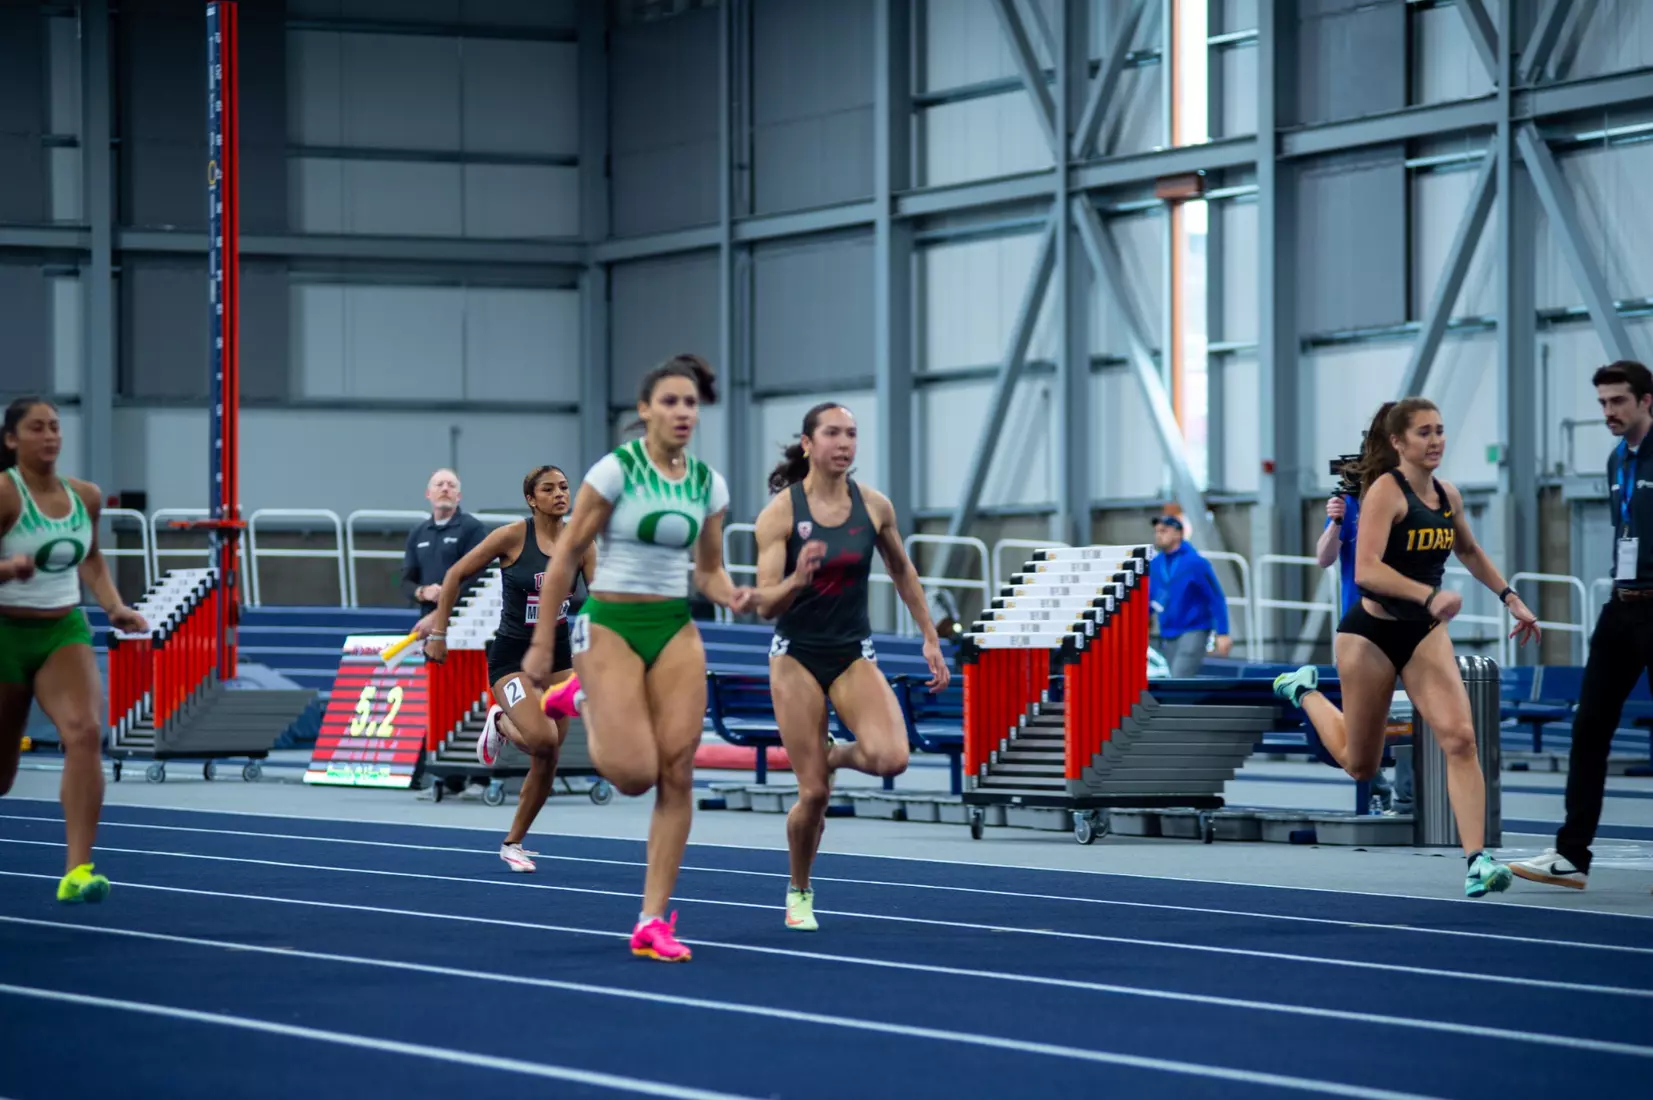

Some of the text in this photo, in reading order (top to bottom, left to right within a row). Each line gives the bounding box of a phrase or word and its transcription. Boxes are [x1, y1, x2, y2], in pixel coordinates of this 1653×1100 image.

[637, 509, 698, 549] O
[1406, 528, 1454, 551] IDAH
[506, 681, 522, 704] 2
[350, 685, 403, 738] 5.2
